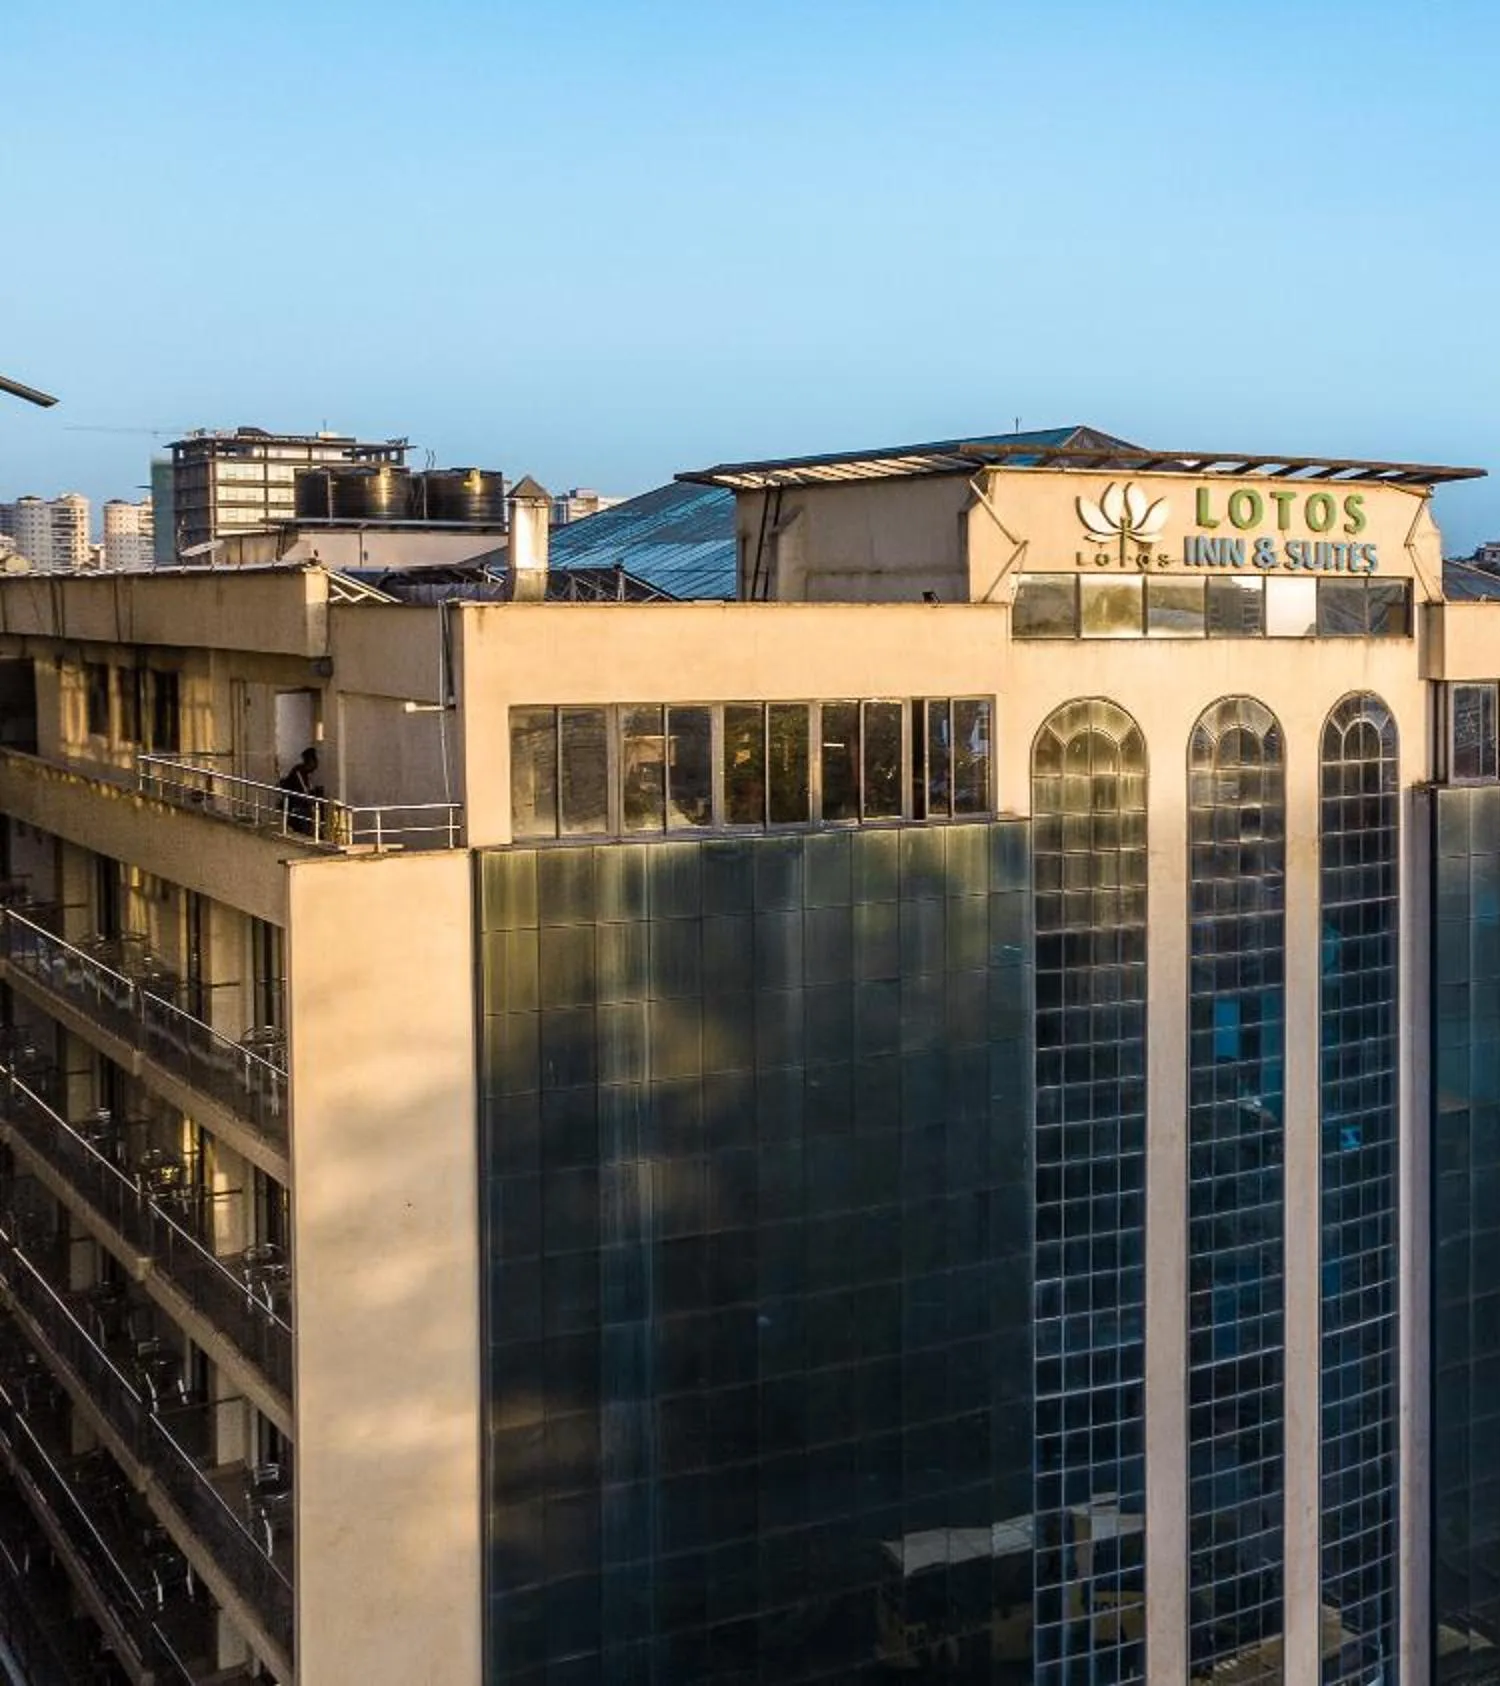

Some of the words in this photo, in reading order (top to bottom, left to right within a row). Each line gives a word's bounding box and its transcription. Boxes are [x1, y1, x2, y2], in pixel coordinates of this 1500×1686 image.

[1196, 487, 1367, 534] LOTOS
[1184, 535, 1246, 568] INN
[1252, 537, 1280, 569] &
[1284, 540, 1379, 573] SUITES
